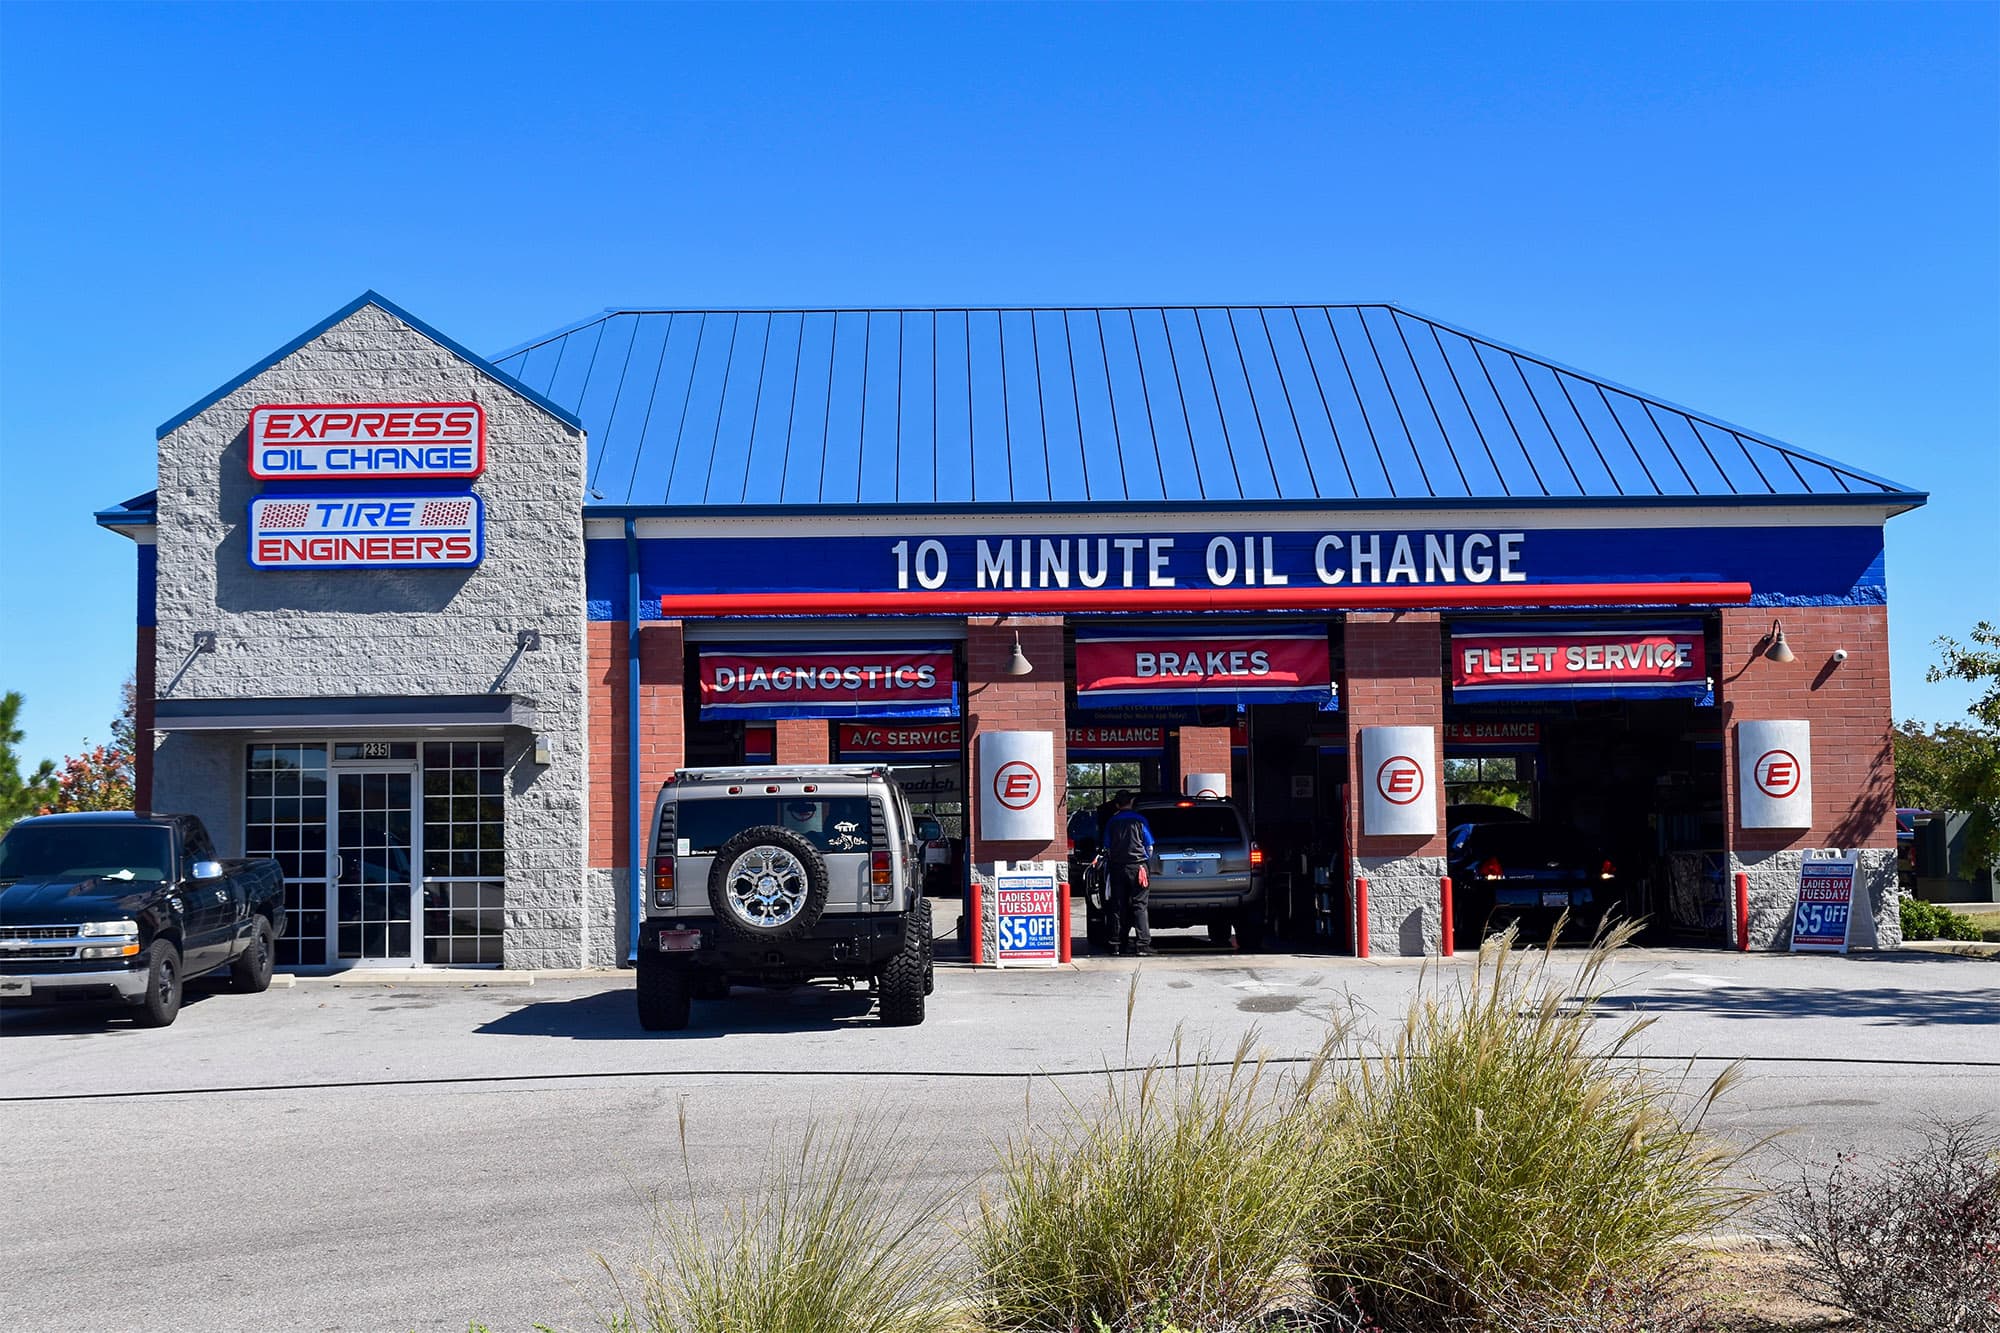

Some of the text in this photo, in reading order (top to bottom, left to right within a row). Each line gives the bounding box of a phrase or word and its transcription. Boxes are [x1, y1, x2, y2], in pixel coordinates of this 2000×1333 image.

[263, 412, 475, 439] EXPRESS
[262, 447, 472, 471] OIL CHANGE
[316, 502, 416, 528] TIRE
[258, 537, 472, 562] ENGINEERS
[891, 533, 1527, 590] 10 MINUTE OIL CHANGE
[1135, 650, 1270, 678] BRAKES
[1463, 643, 1693, 674] FLEET SERVICE
[714, 664, 937, 693] DIAGNOSTICS
[851, 729, 961, 746] A/C SERVICE
[1065, 727, 1160, 742] TE & BALANCE
[1463, 723, 1472, 737] &
[1475, 722, 1536, 737] BALANCE
[366, 743, 386, 755] 235
[1004, 774, 1034, 798] E
[1387, 769, 1417, 793] E
[1765, 762, 1793, 786] E
[1801, 888, 1849, 900] TUESDAY!
[1802, 879, 1850, 889] LADIES DAY
[999, 891, 1052, 902] LADIES DAY
[999, 901, 1053, 913] TUESDAY!
[1796, 902, 1848, 935] $5 OFF
[999, 916, 1054, 950] $5 OFF
